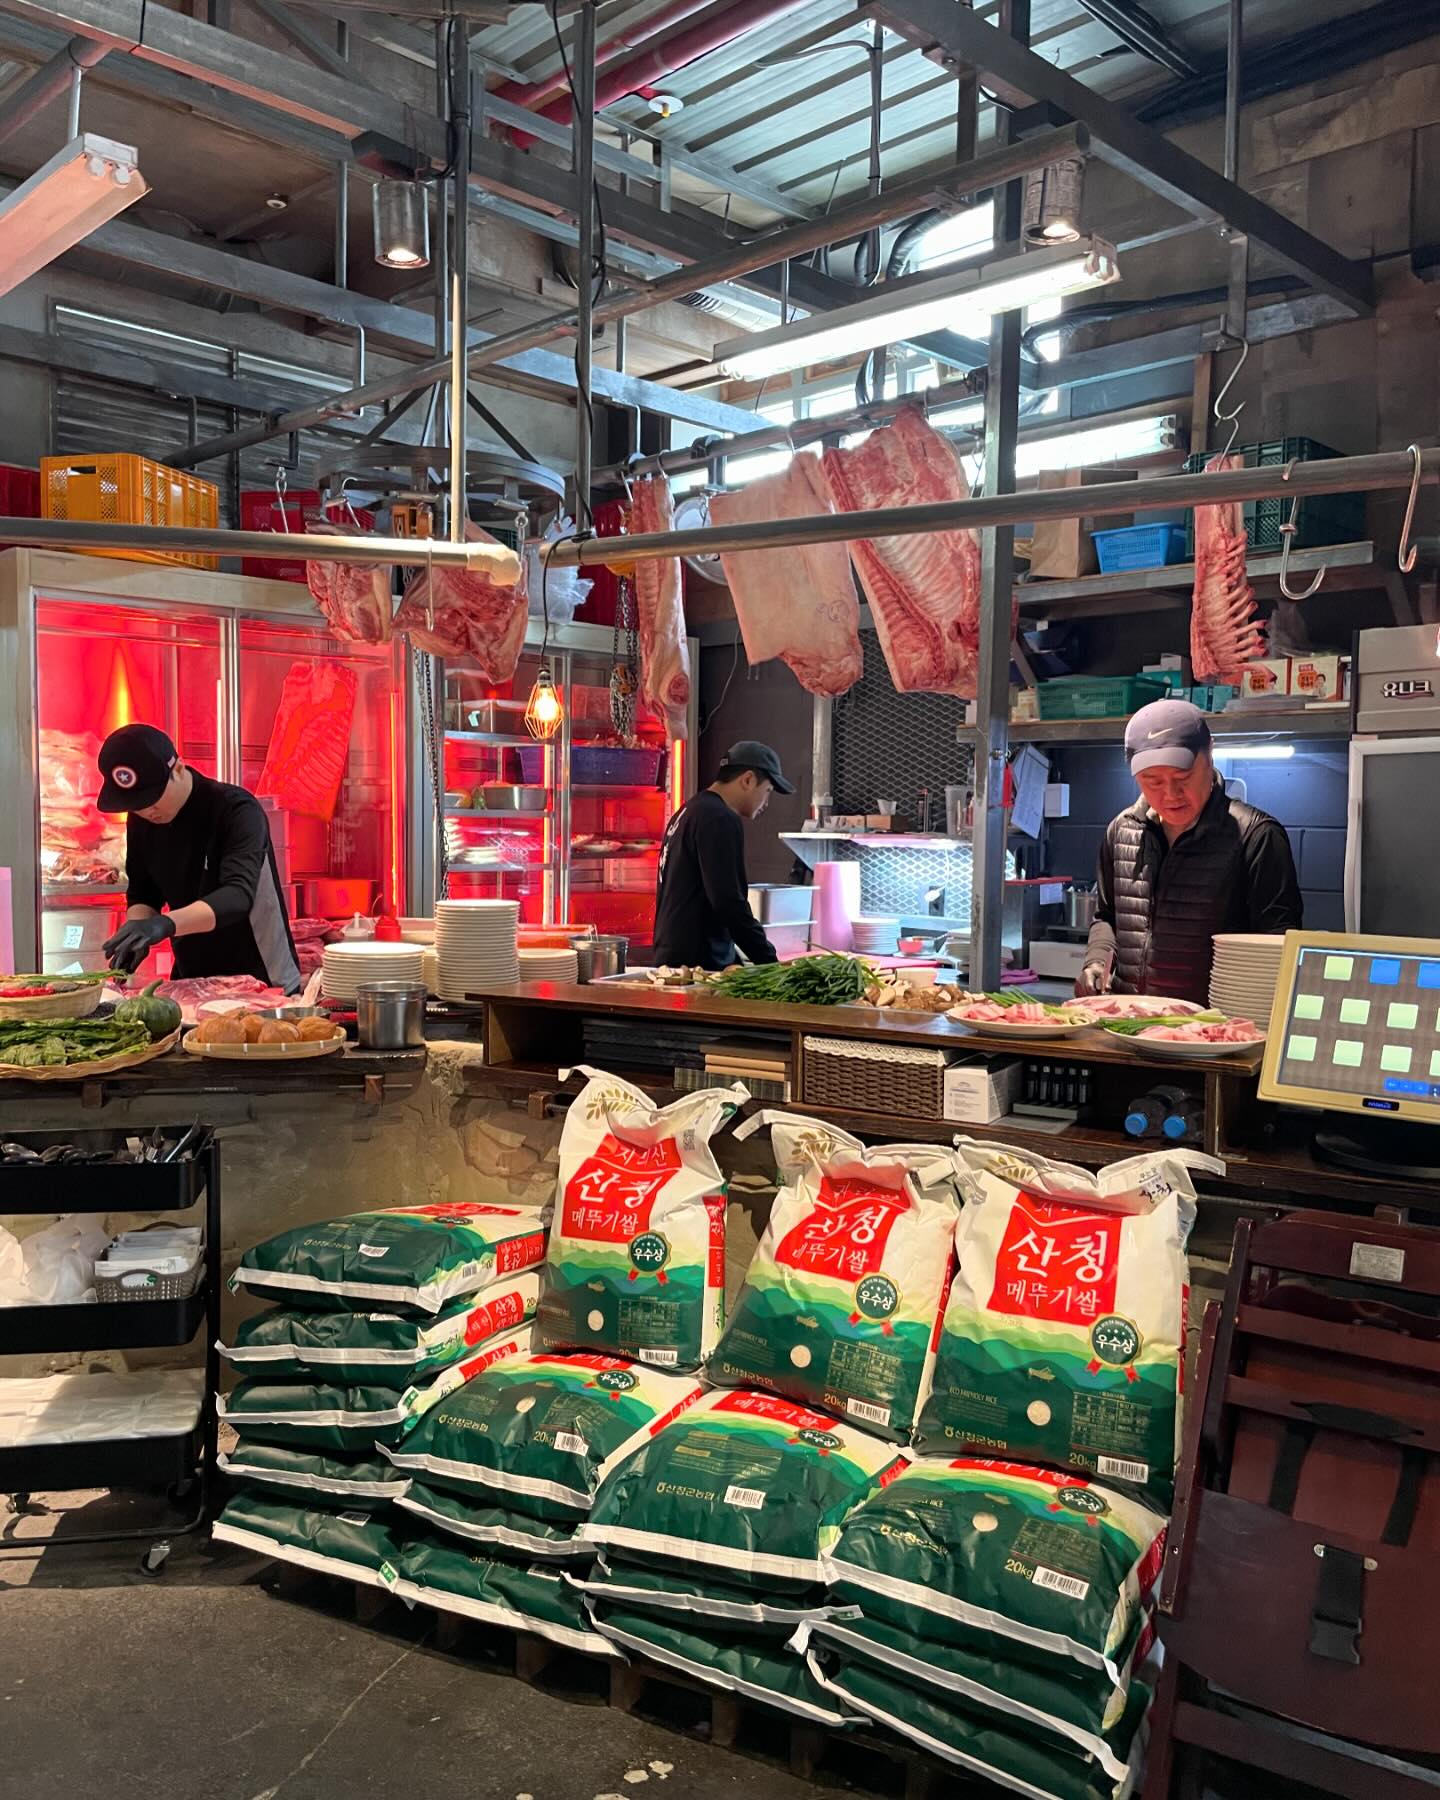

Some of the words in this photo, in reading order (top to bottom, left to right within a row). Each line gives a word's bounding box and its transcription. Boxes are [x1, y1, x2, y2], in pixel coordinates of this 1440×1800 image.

[1383, 680, 1430, 697] 유니크
[571, 1206, 639, 1236] 메뚜기쌀
[804, 1205, 890, 1244] 산청
[633, 1247, 665, 1262] 우수상
[1008, 1227, 1109, 1283] 산청
[495, 1295, 517, 1316] 산청
[859, 1290, 894, 1311] 우수상
[1006, 1279, 1102, 1317] 메뚜기쌀
[1095, 1334, 1135, 1354] 우수상
[824, 1393, 847, 1410] 20kg
[533, 1431, 555, 1447] 20kg
[1069, 1452, 1096, 1472] 20kg
[1004, 1558, 1034, 1580] 20kg
